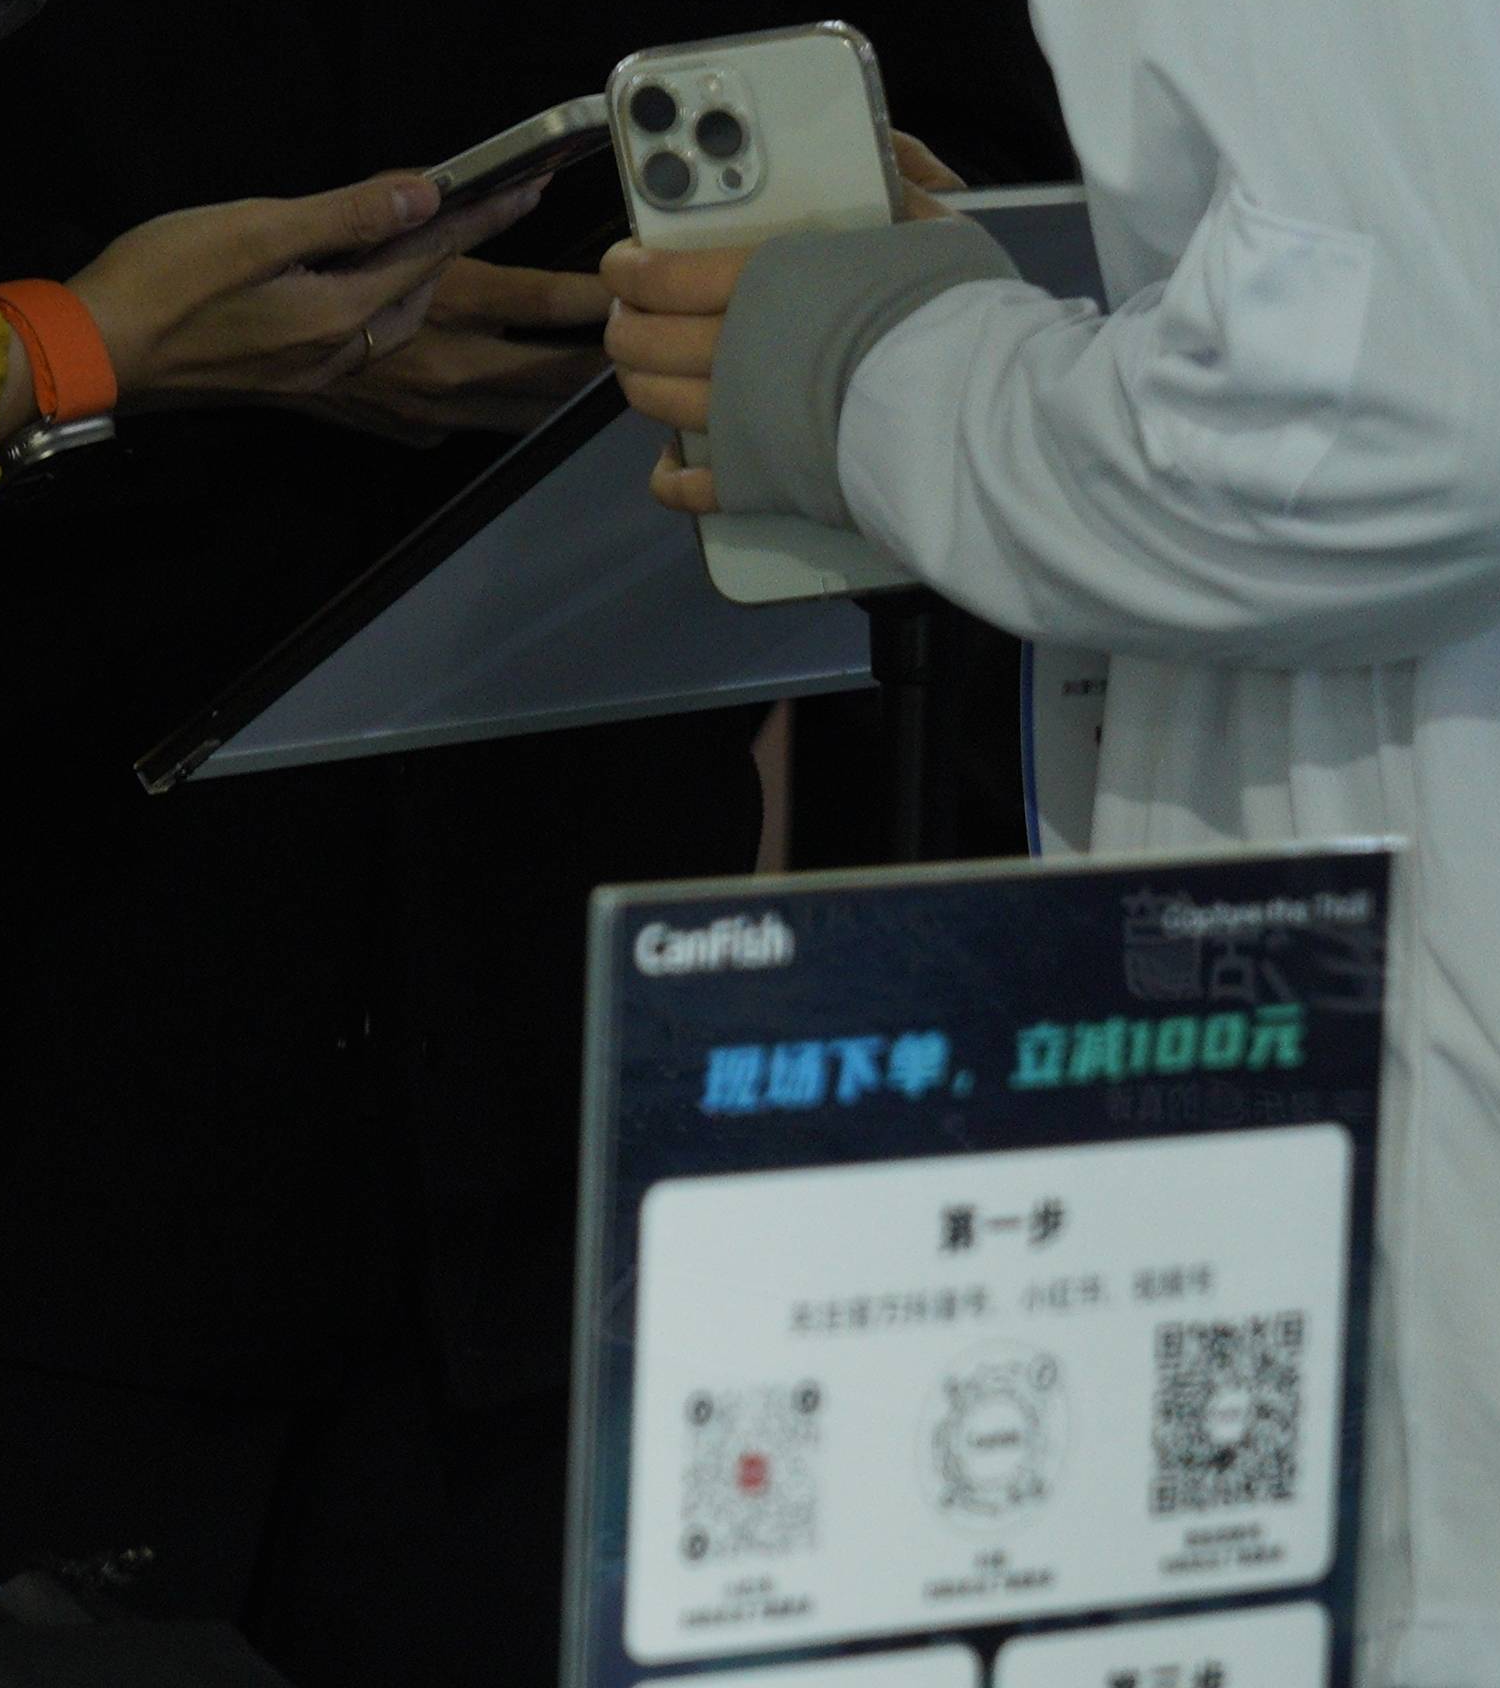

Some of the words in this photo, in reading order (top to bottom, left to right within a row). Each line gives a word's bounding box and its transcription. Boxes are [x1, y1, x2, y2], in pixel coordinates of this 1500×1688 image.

[635, 912, 796, 976] CanFish
[938, 1197, 1068, 1254] 第一步
